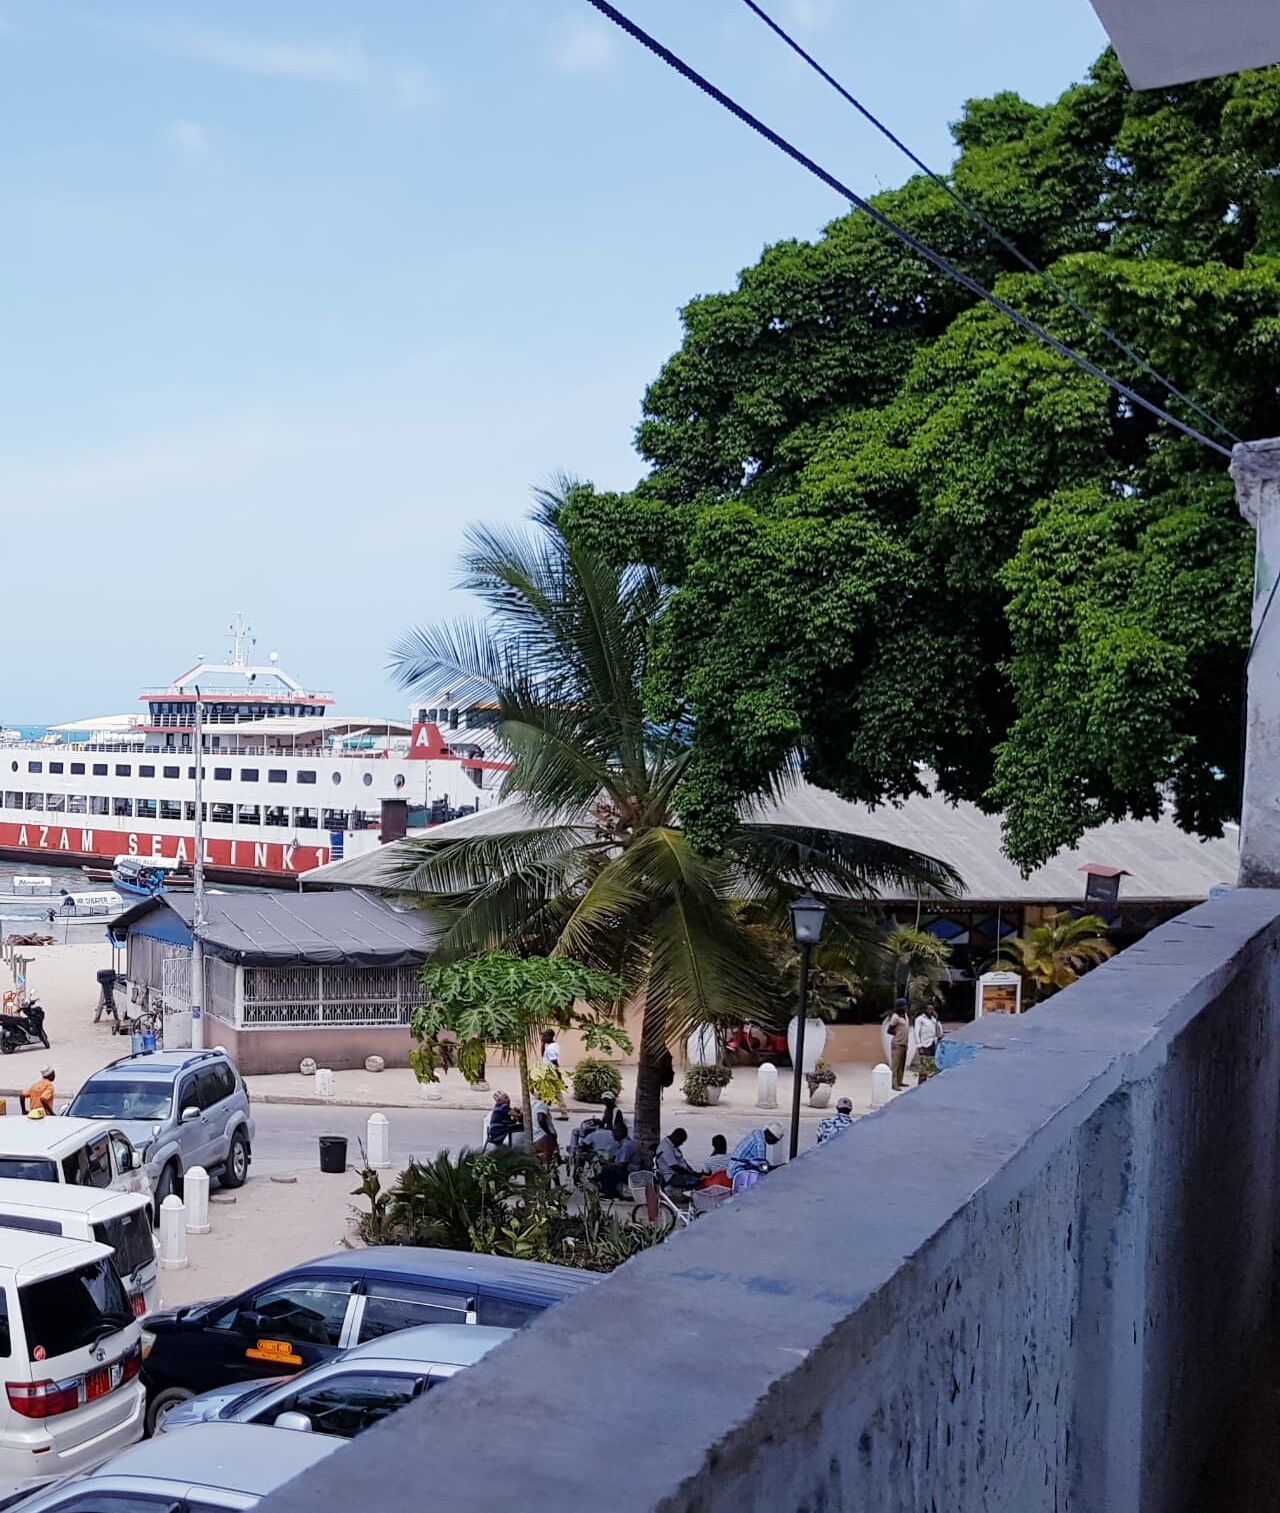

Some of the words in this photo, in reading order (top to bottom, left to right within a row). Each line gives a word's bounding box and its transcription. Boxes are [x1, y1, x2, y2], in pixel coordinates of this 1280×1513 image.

[416, 726, 430, 748] A
[18, 825, 94, 852] AZAM
[128, 833, 295, 871] SEALINK
